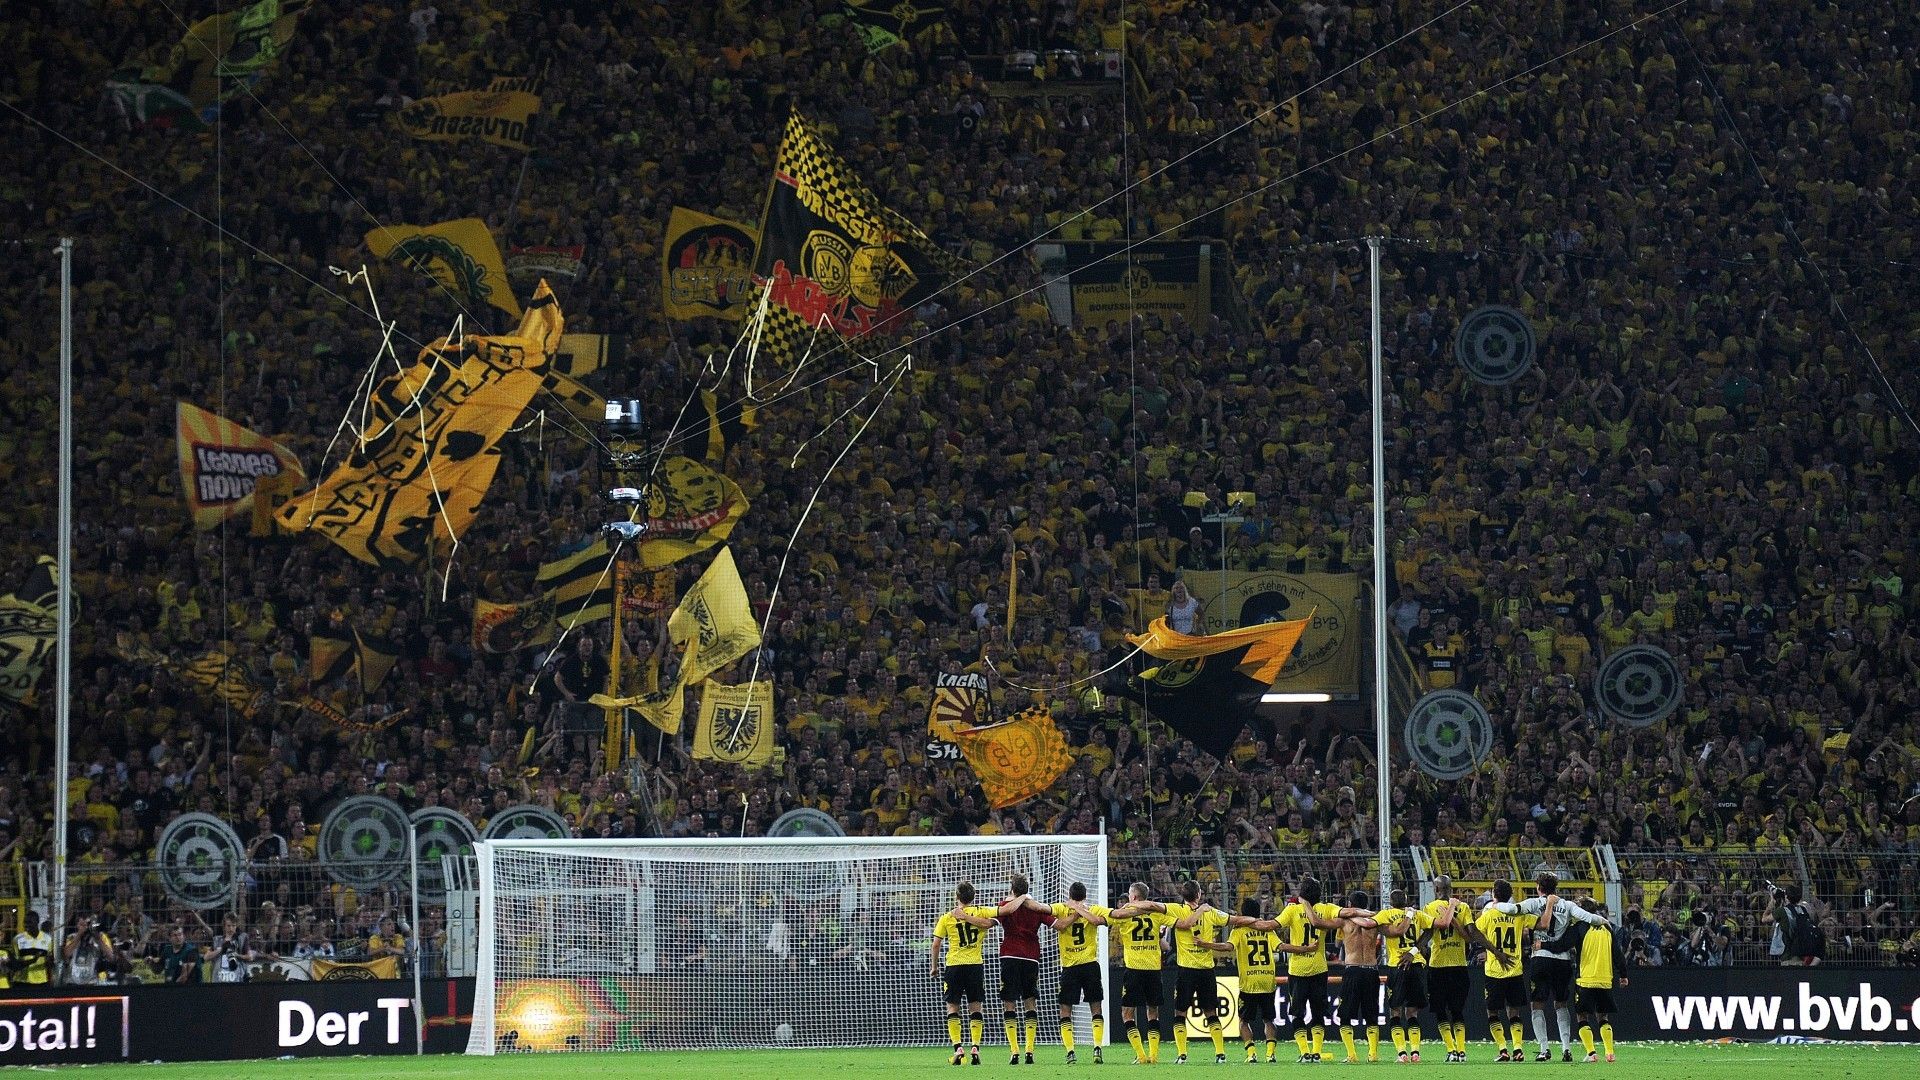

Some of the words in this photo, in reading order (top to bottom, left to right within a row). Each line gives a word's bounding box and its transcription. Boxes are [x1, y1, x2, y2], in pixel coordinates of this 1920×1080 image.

[1076, 283, 1118, 294] Fanclub
[1136, 302, 1186, 311] DORTMUND
[1258, 579, 1287, 594] stehen
[1290, 587, 1306, 600] mit
[956, 921, 979, 948] 16
[1071, 922, 1085, 946] 9
[1131, 917, 1155, 942] 22
[1495, 926, 1517, 952] 14
[1247, 940, 1270, 966] 23
[278, 1000, 369, 1047] Der
